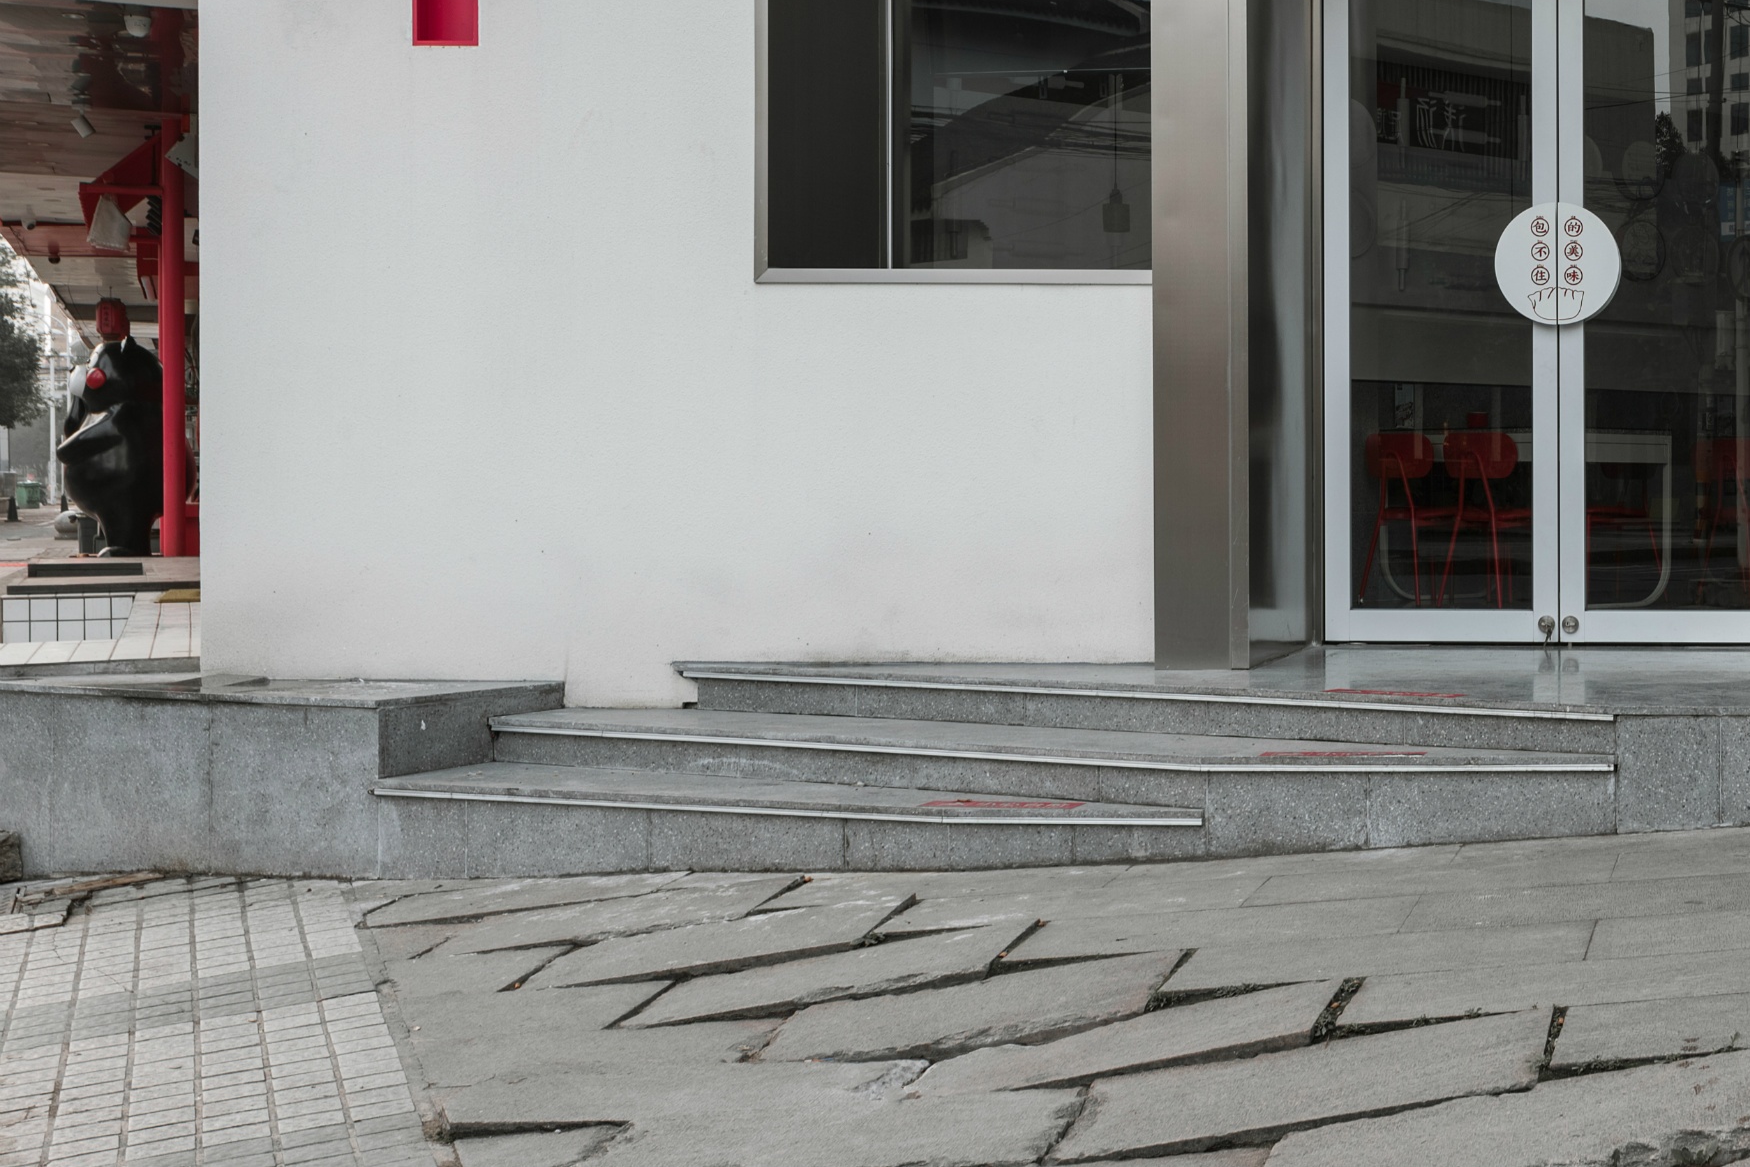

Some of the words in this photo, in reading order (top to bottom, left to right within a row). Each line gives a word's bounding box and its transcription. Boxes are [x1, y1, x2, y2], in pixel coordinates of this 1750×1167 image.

[1532, 220, 1548, 282] 包不住
[1566, 221, 1581, 283] 的美味
